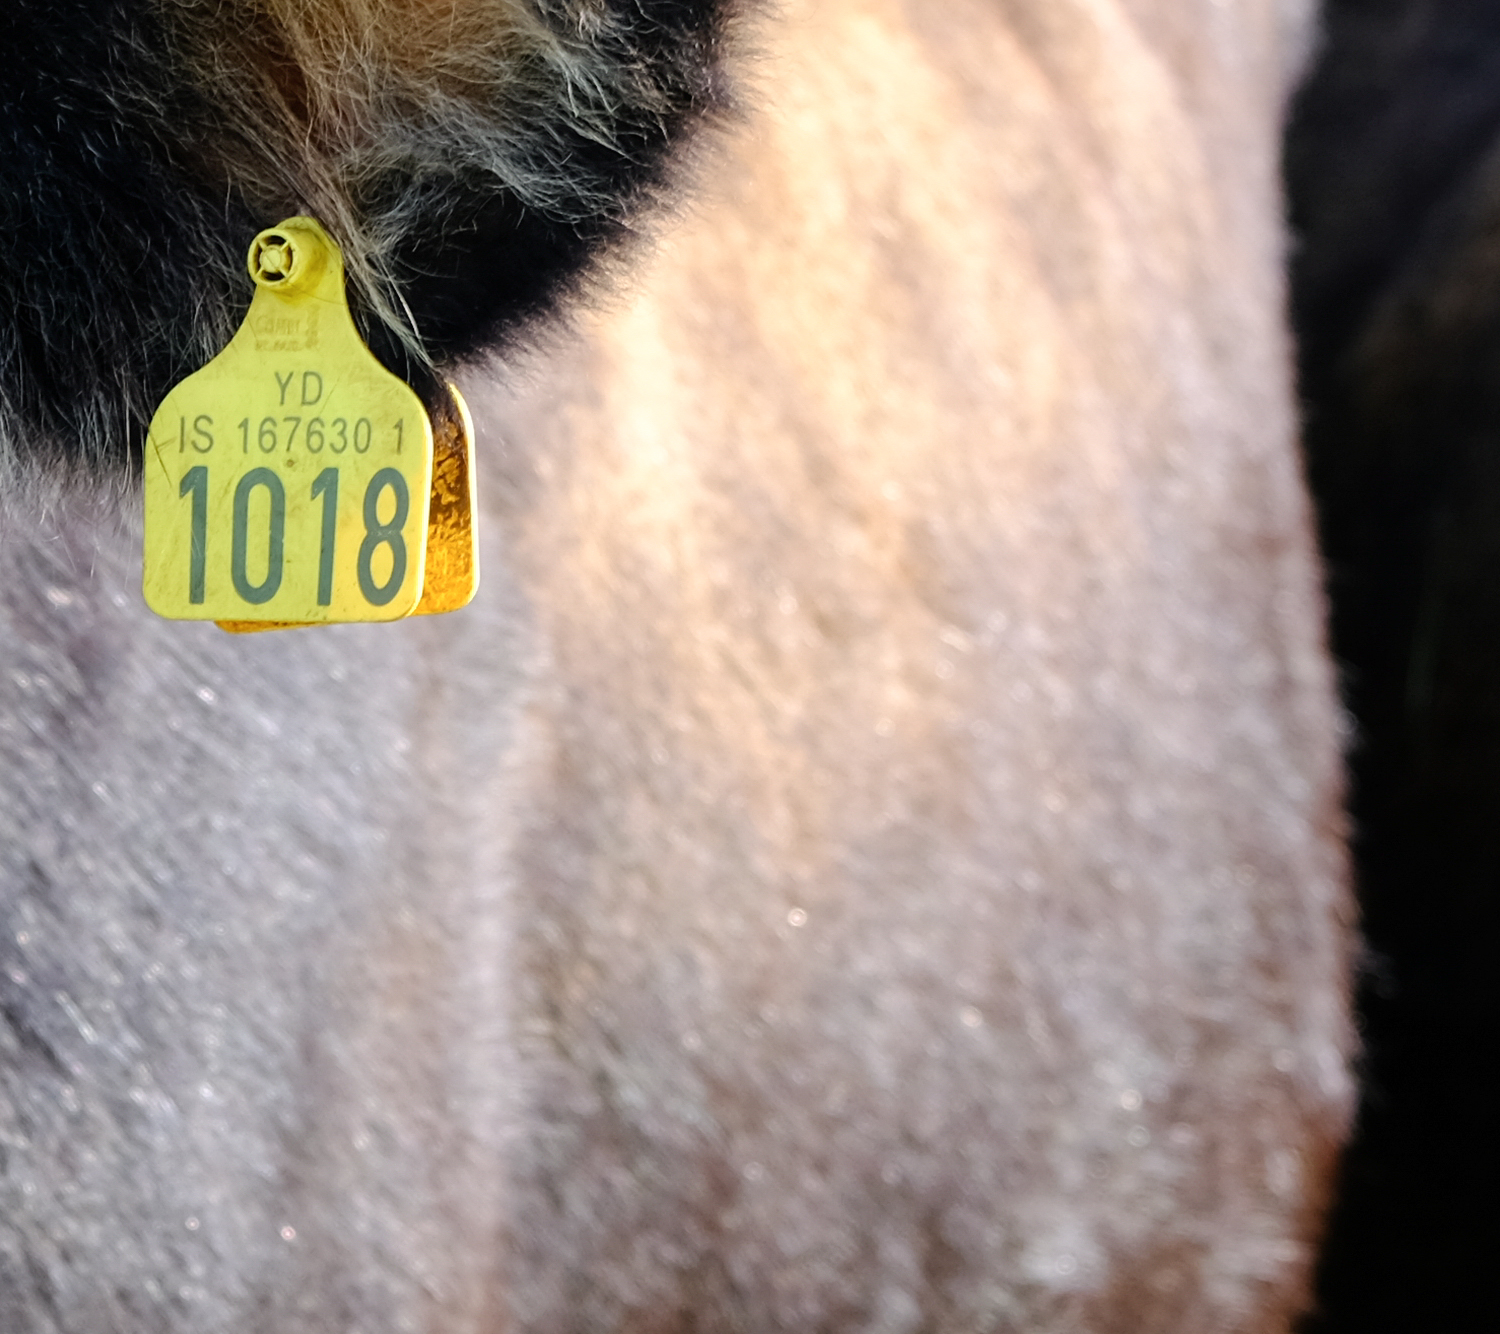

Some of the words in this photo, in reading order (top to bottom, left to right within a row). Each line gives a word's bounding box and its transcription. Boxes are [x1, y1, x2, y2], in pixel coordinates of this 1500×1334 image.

[274, 371, 323, 406] YD
[179, 415, 214, 454] IS
[237, 417, 372, 454] 167630
[393, 418, 405, 455] 1
[179, 465, 410, 607] 1018
